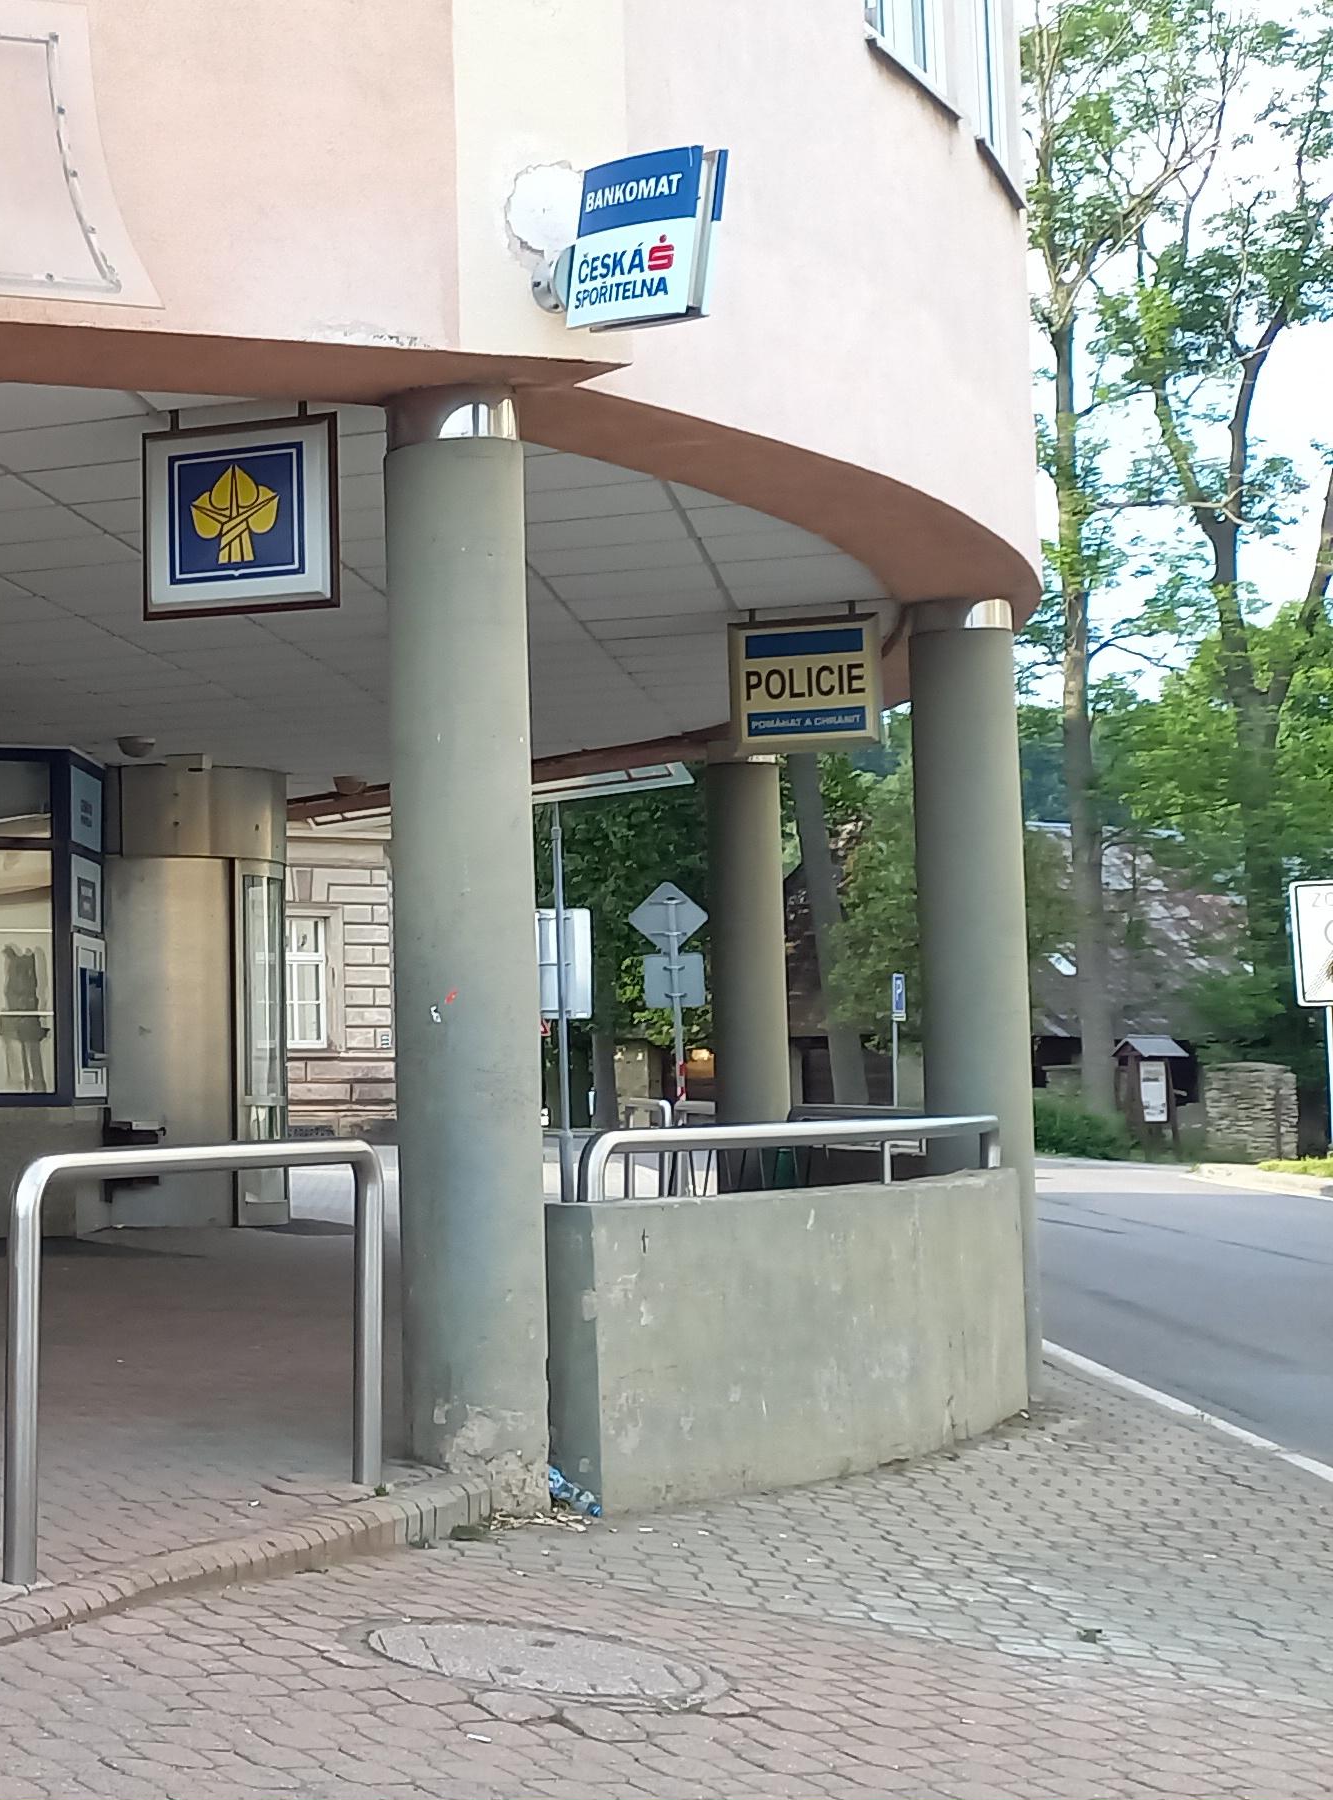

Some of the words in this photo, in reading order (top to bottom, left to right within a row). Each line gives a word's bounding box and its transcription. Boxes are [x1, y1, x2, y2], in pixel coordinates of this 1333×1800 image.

[584, 172, 683, 214] BANKOMAT
[577, 242, 645, 285] ČESKÁ
[574, 276, 669, 310] SPOŘITELNA
[745, 662, 866, 701] POLICIE
